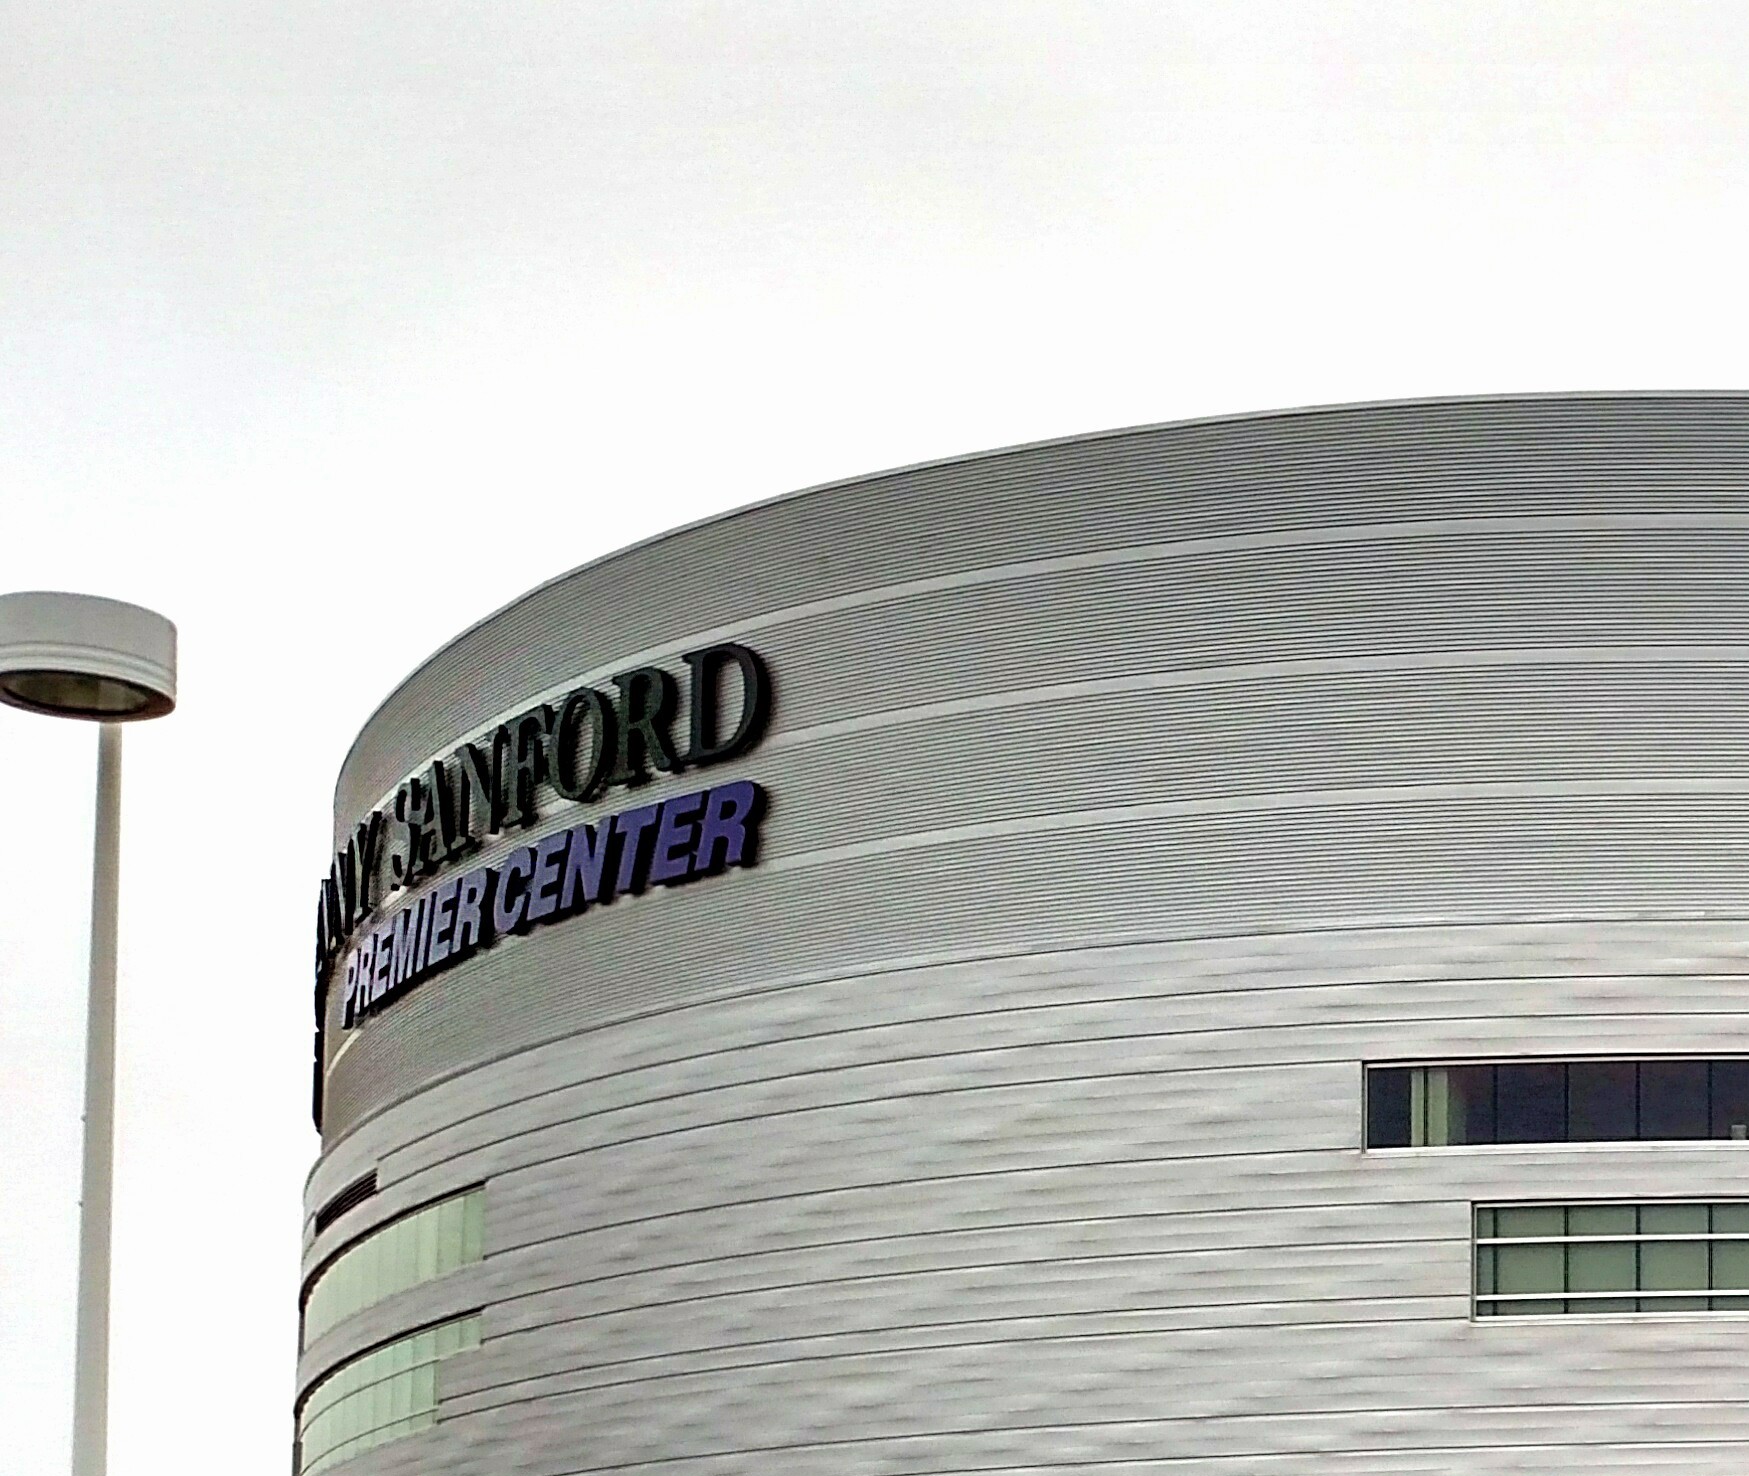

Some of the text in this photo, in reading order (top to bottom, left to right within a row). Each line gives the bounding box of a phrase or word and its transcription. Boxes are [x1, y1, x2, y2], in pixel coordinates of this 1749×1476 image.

[393, 641, 774, 890] SANFORD
[341, 779, 770, 1029] PREMIER CENTER
